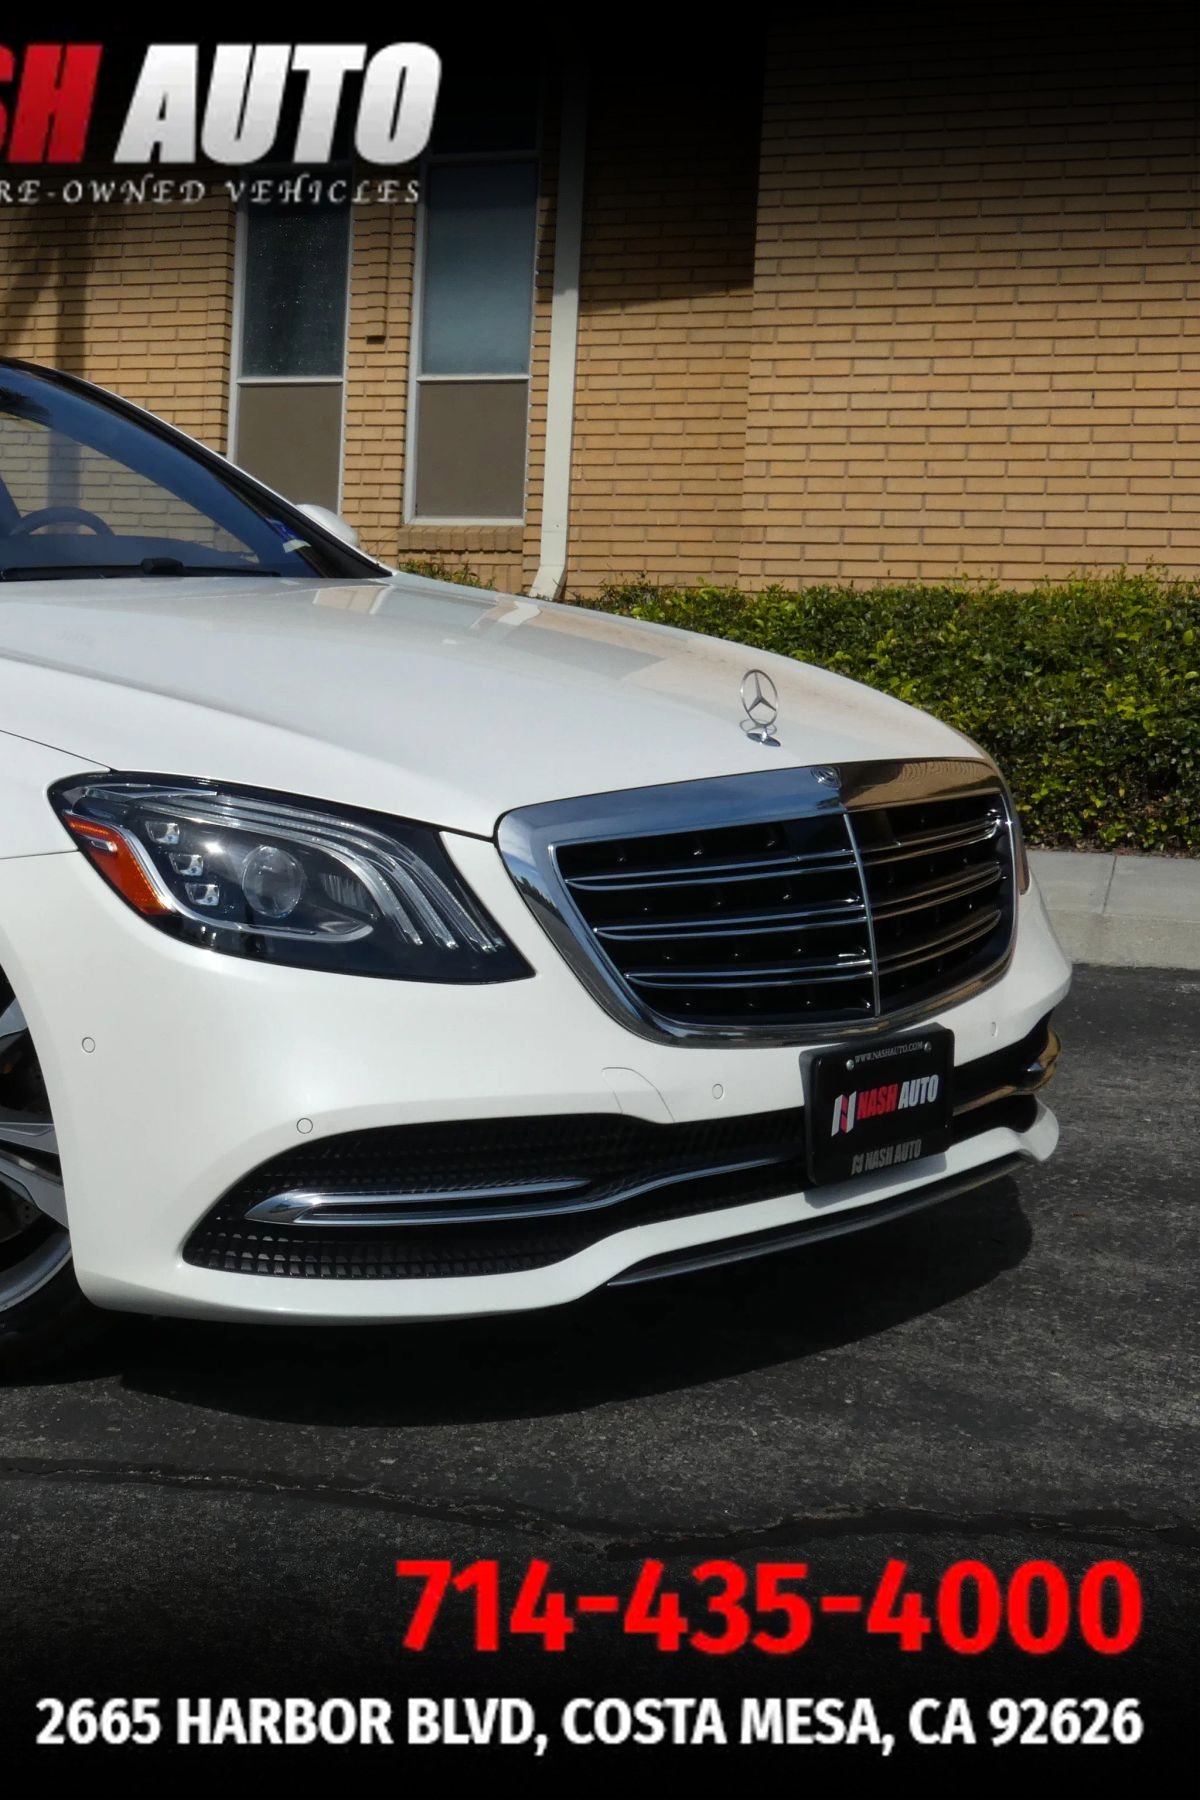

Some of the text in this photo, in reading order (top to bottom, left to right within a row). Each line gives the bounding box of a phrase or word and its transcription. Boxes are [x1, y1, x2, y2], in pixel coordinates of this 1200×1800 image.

[856, 1074, 940, 1120] NASH AUTO
[865, 1146, 894, 1172] NASH
[893, 1139, 922, 1163] AUTO
